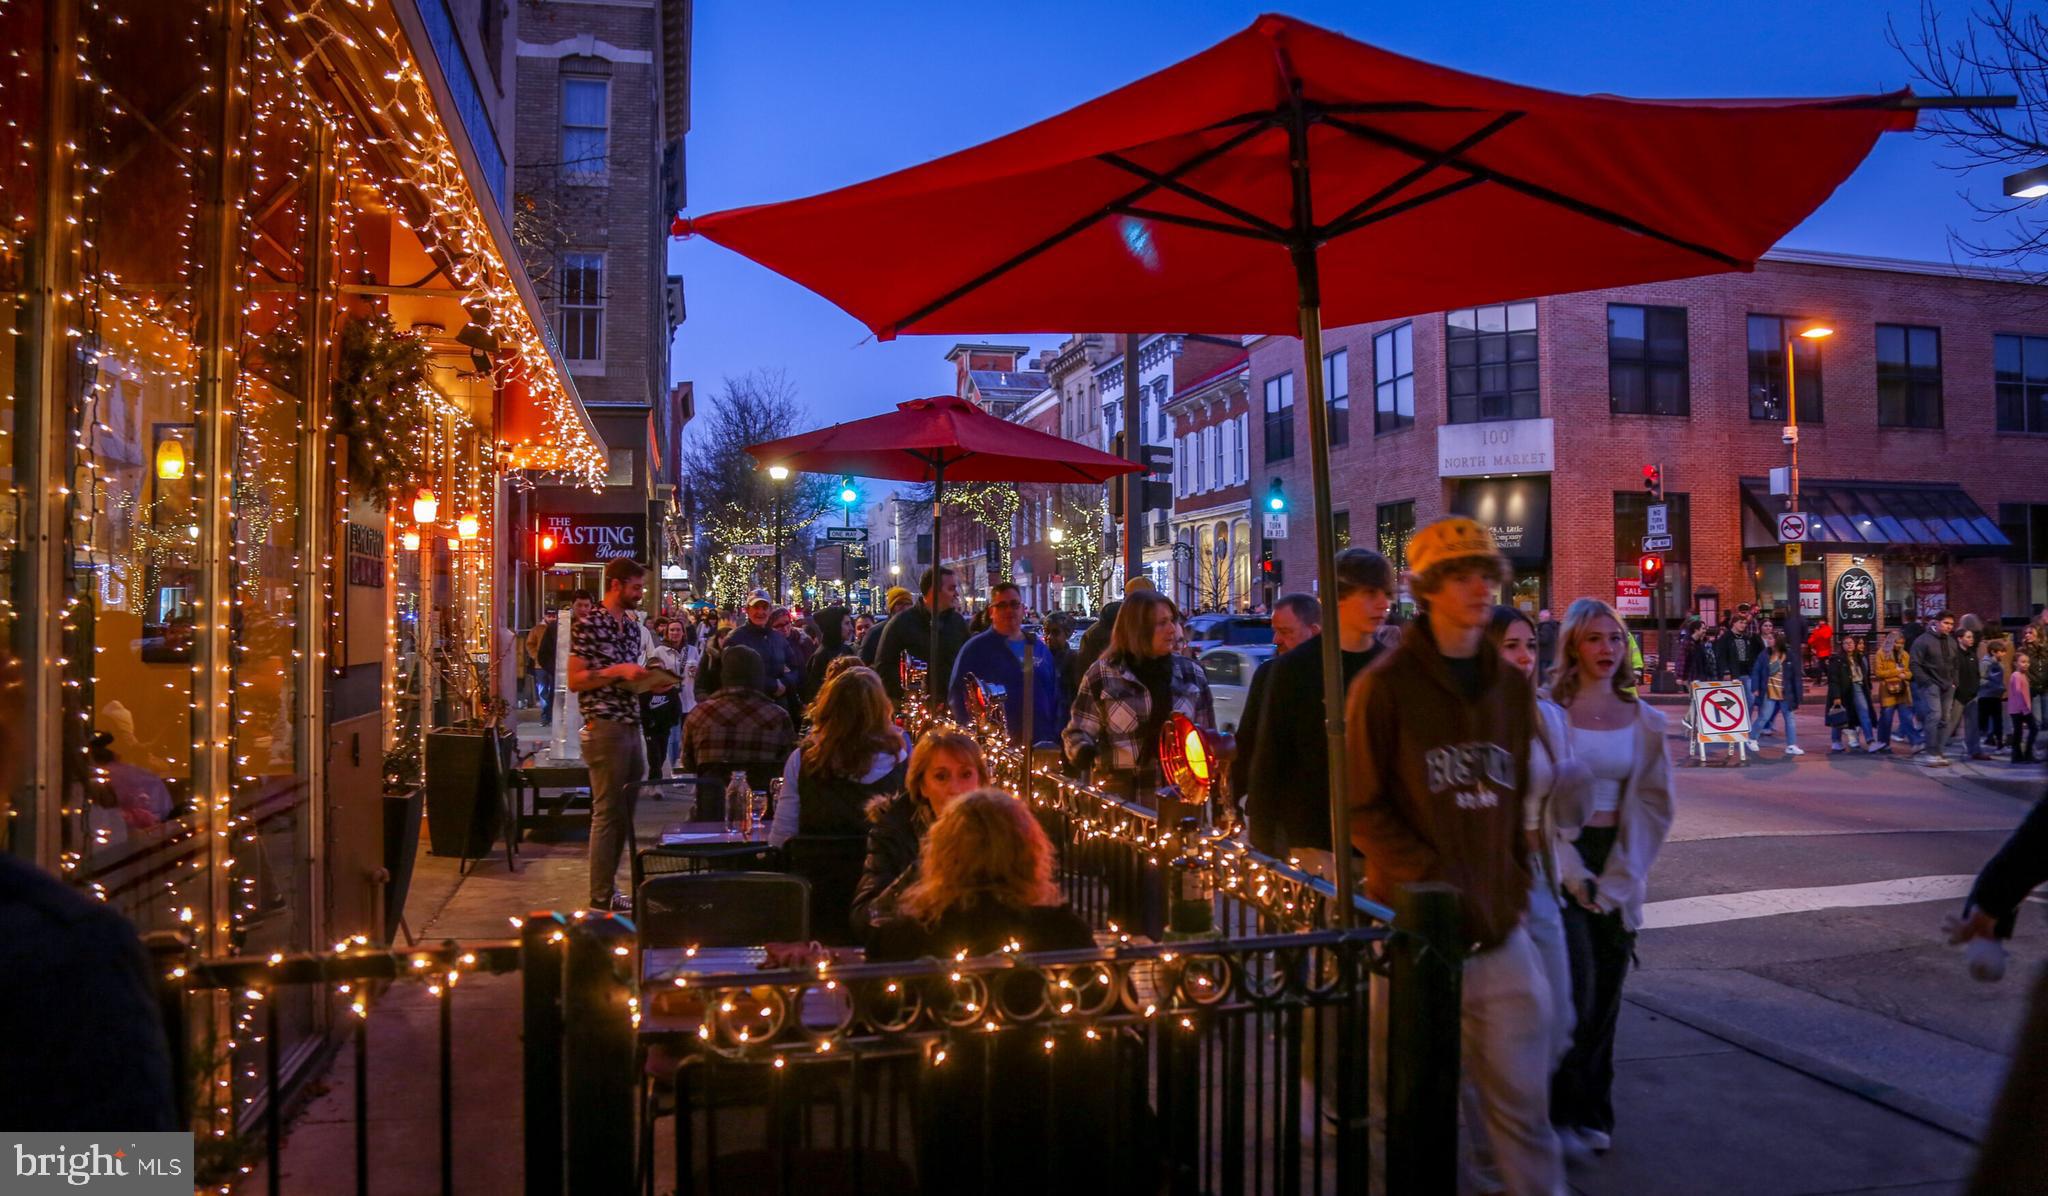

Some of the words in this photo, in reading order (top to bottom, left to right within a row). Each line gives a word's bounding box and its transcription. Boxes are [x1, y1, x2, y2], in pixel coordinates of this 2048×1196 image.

[1481, 429, 1509, 445] 100
[1444, 456, 1486, 469] NORTH
[1493, 453, 1546, 467] MARKET
[548, 517, 571, 527] THE
[548, 526, 635, 545] TASTING
[595, 542, 637, 558] Room
[1845, 580, 1863, 590] The
[1844, 590, 1868, 600] Cellar
[1800, 598, 1819, 609] ALE
[1847, 600, 1869, 610] Door
